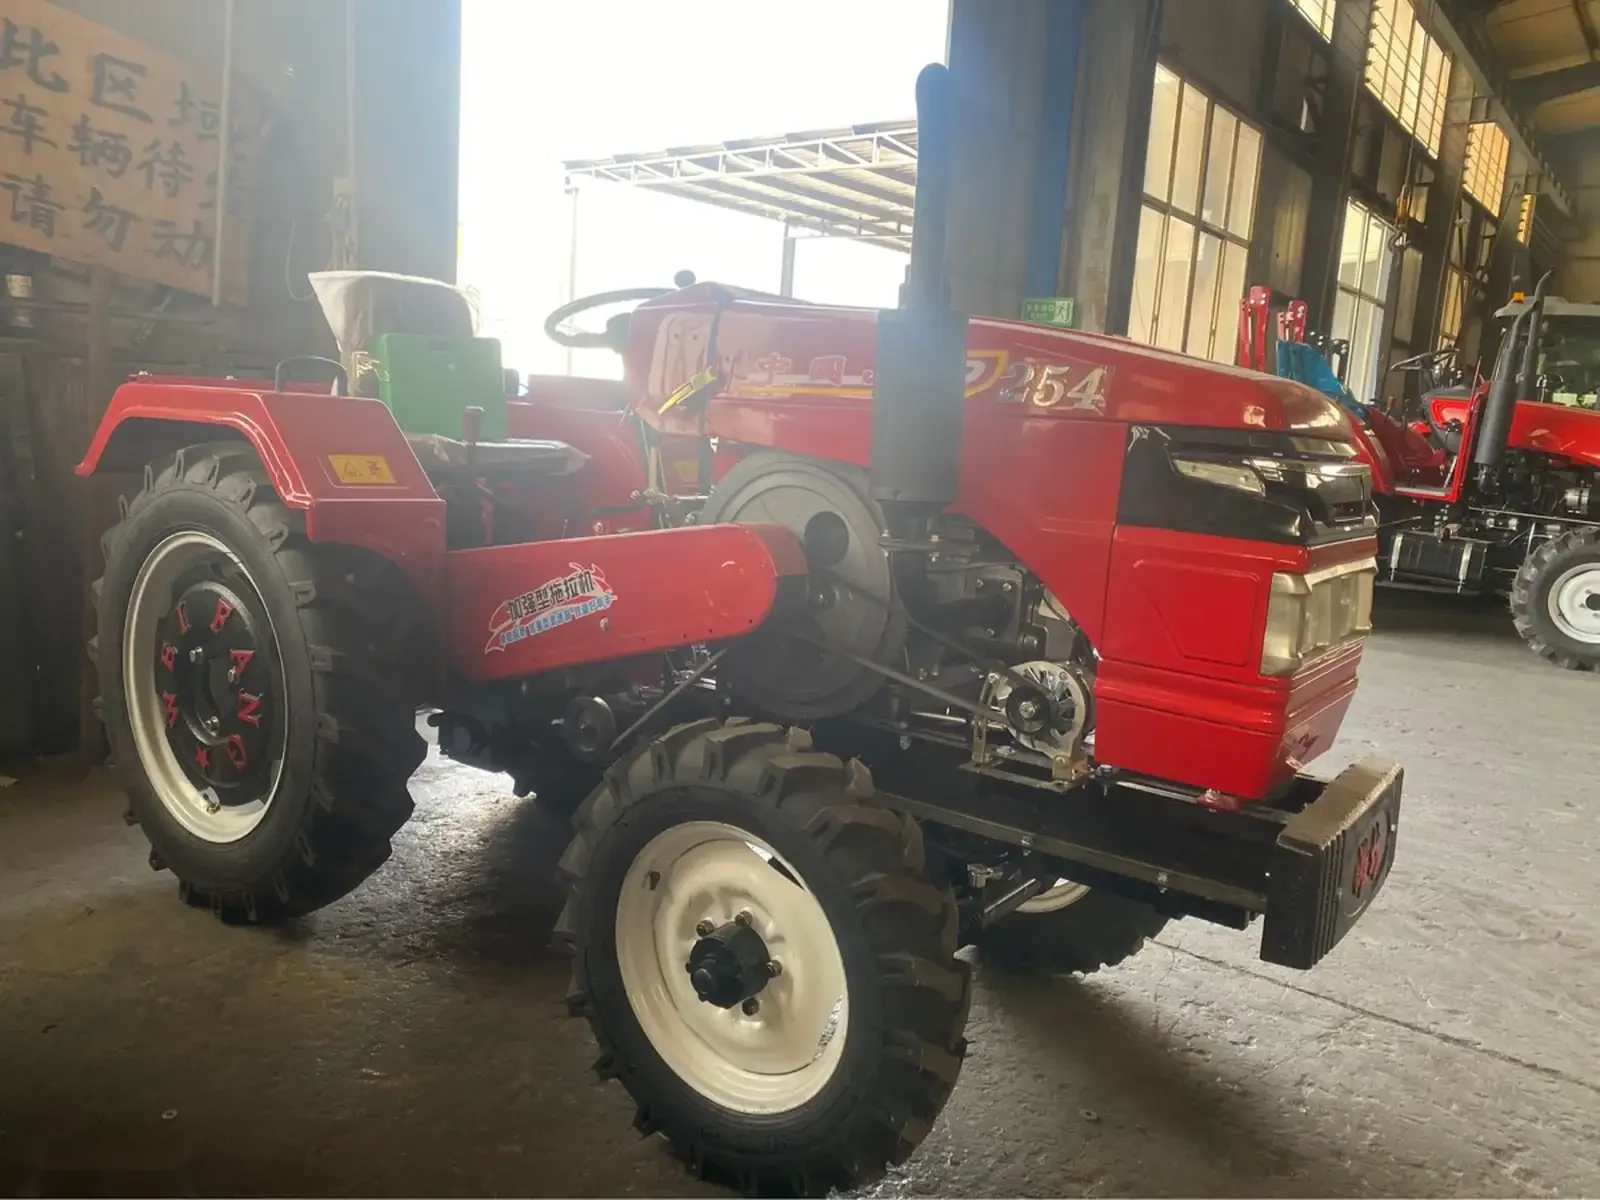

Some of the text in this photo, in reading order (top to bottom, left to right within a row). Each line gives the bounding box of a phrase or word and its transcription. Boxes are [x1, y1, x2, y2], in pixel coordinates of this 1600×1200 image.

[999, 361, 1106, 410] 254
[508, 570, 596, 621] 加强型拖拉机
